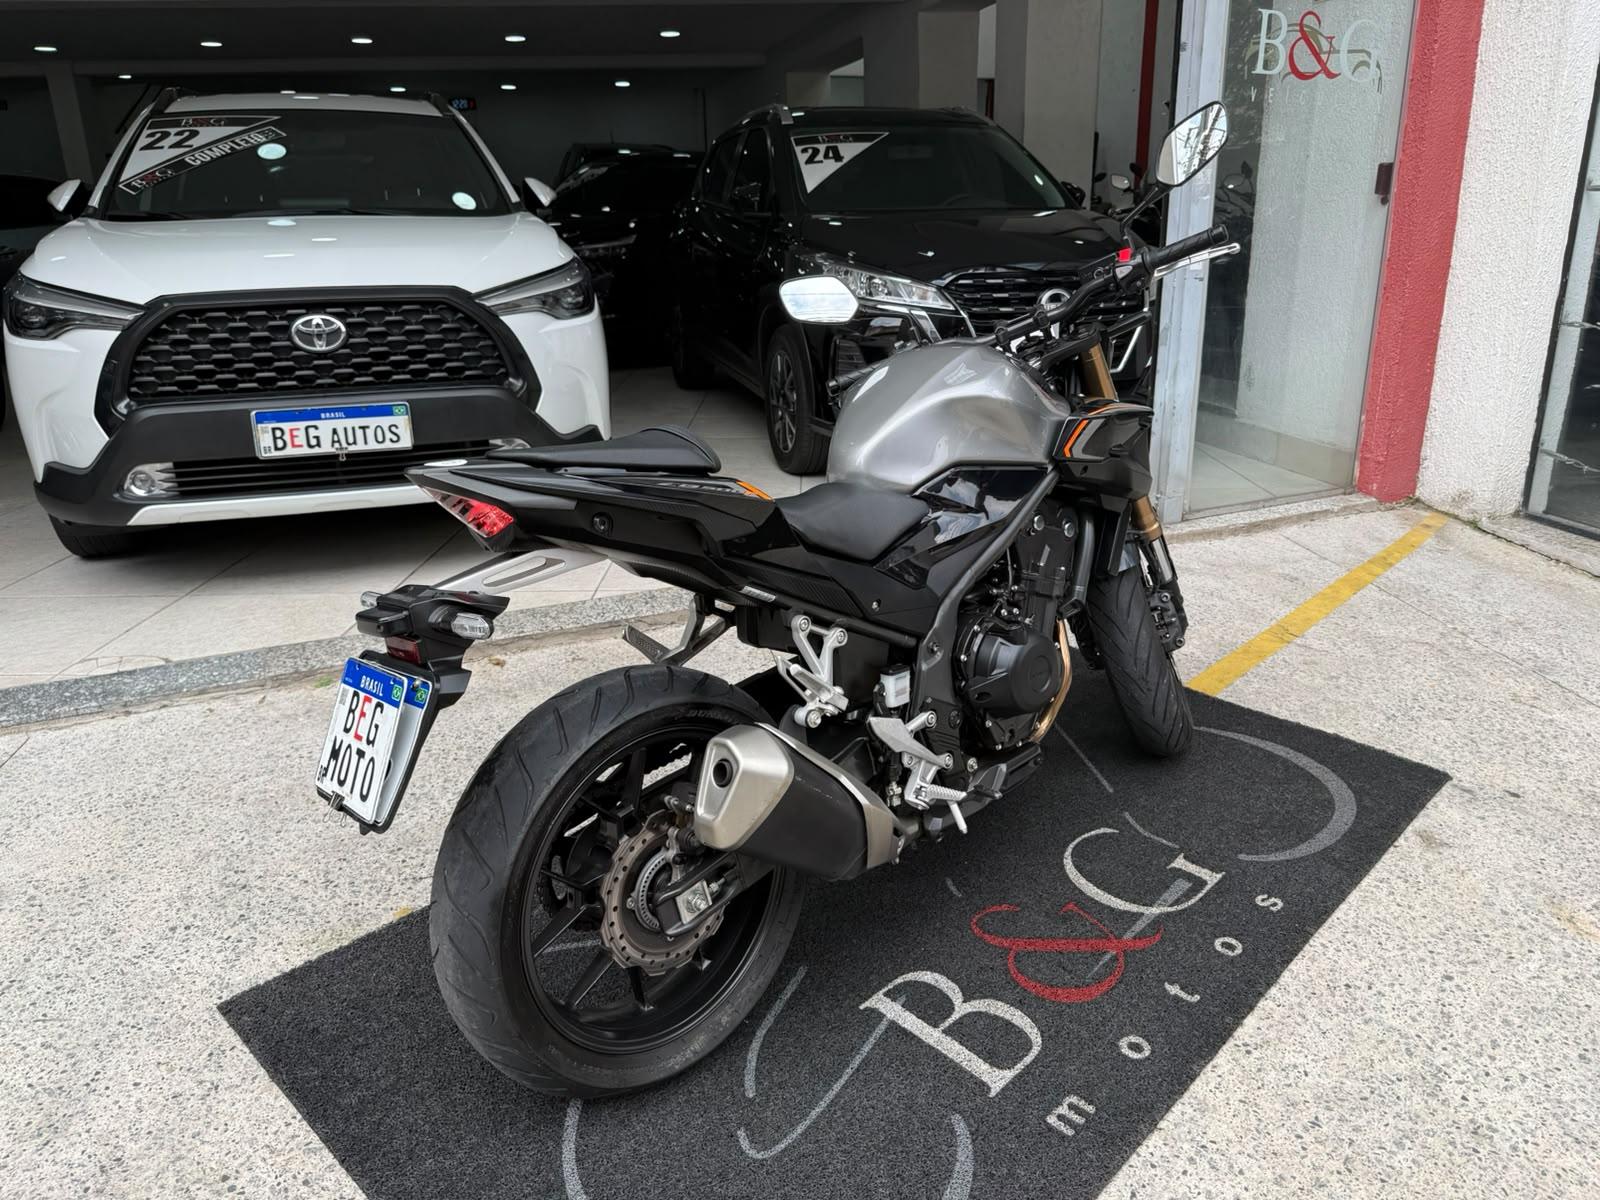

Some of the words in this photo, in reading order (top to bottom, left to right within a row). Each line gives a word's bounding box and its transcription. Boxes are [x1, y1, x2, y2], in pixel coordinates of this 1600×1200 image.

[1251, 8, 1380, 82] B&G
[139, 129, 200, 151] 22
[184, 132, 266, 166] COMPLETO
[801, 145, 845, 165] 24
[271, 424, 322, 452] BEG
[331, 424, 401, 448] AUTOS
[360, 675, 384, 697] BRASIL
[343, 689, 385, 748] BEG
[325, 735, 376, 803] MOTO
[858, 827, 1226, 1098] B&G
[1045, 893, 1284, 1137] motos
